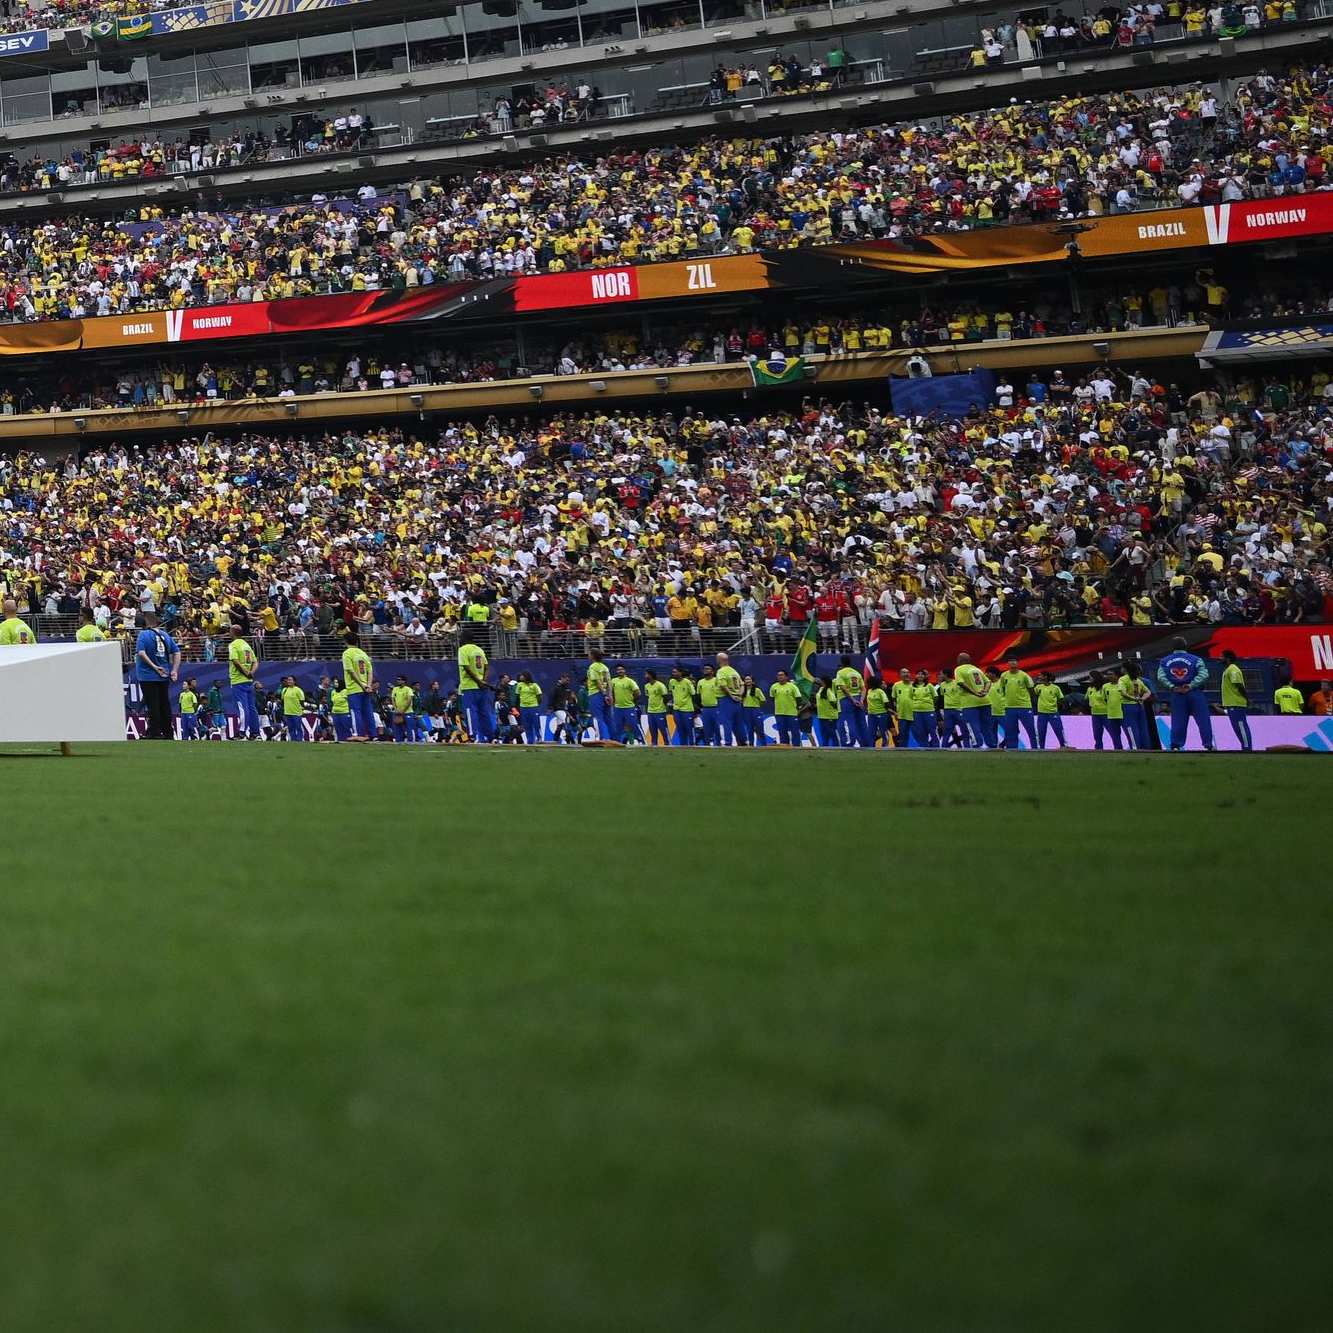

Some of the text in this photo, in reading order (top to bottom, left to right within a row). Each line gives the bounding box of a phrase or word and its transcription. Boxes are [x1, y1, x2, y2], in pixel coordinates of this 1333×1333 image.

[1138, 222, 1186, 239] BRAZIL
[1246, 208, 1306, 228] NORWAY
[591, 272, 631, 299] NOR
[686, 264, 717, 290] ZIL
[123, 322, 154, 336] BRAZIL
[192, 315, 232, 330] NORWAY
